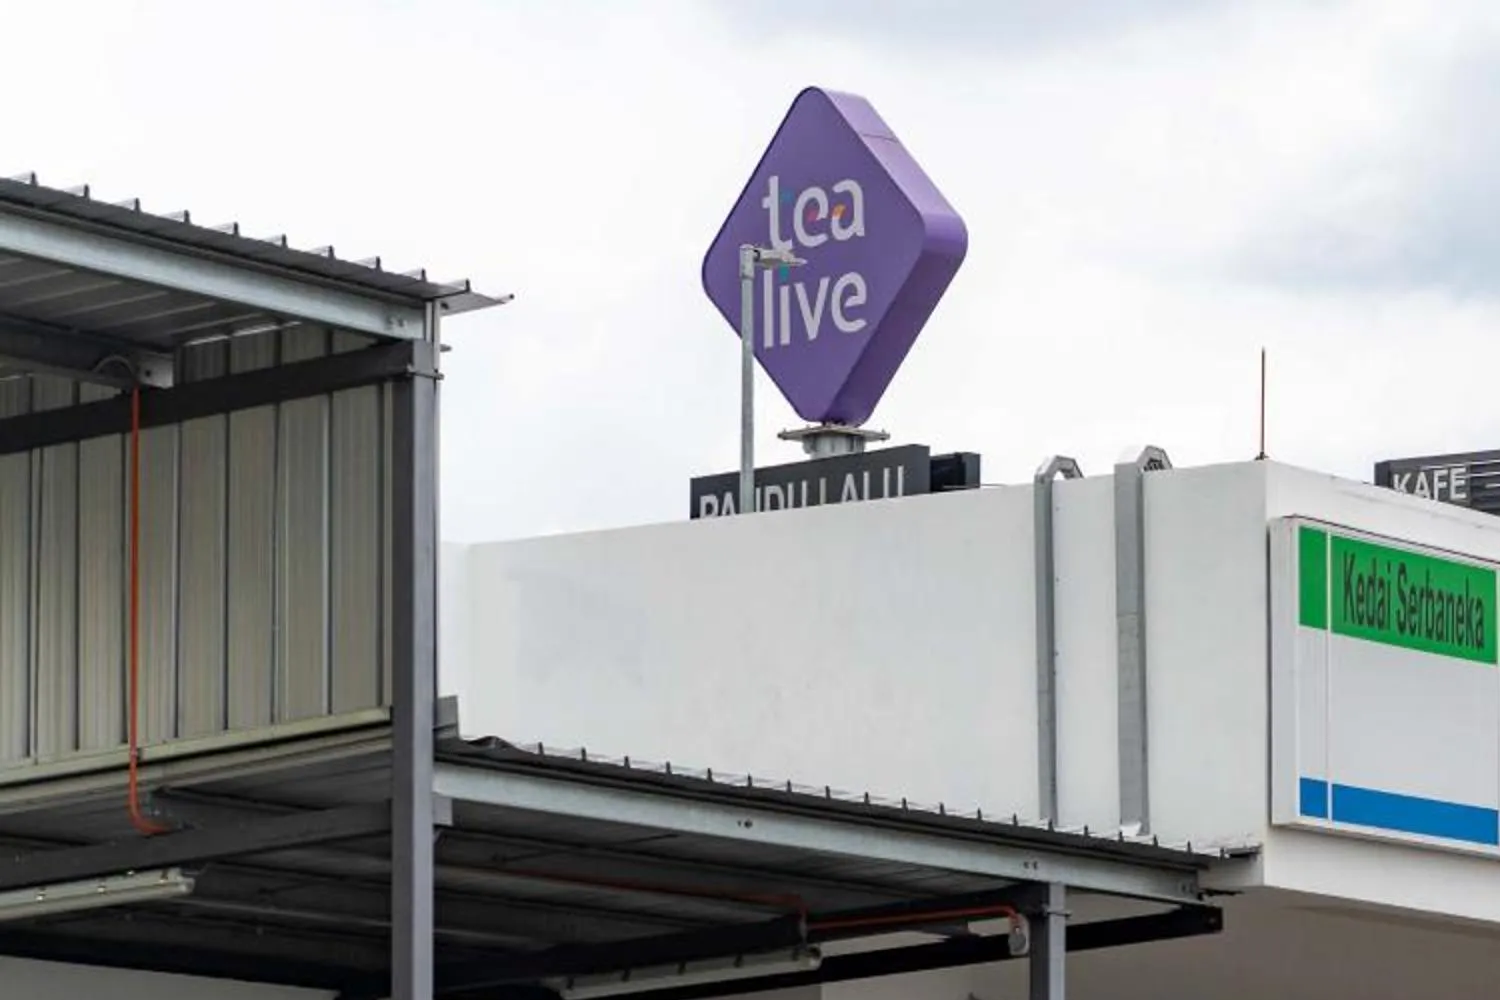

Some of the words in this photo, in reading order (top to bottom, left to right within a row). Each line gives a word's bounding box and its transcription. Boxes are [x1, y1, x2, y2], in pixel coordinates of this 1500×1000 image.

[762, 175, 866, 251] tea
[762, 266, 868, 350] live
[1343, 551, 1392, 630] Kedai
[1396, 561, 1486, 652] Serbaneka
